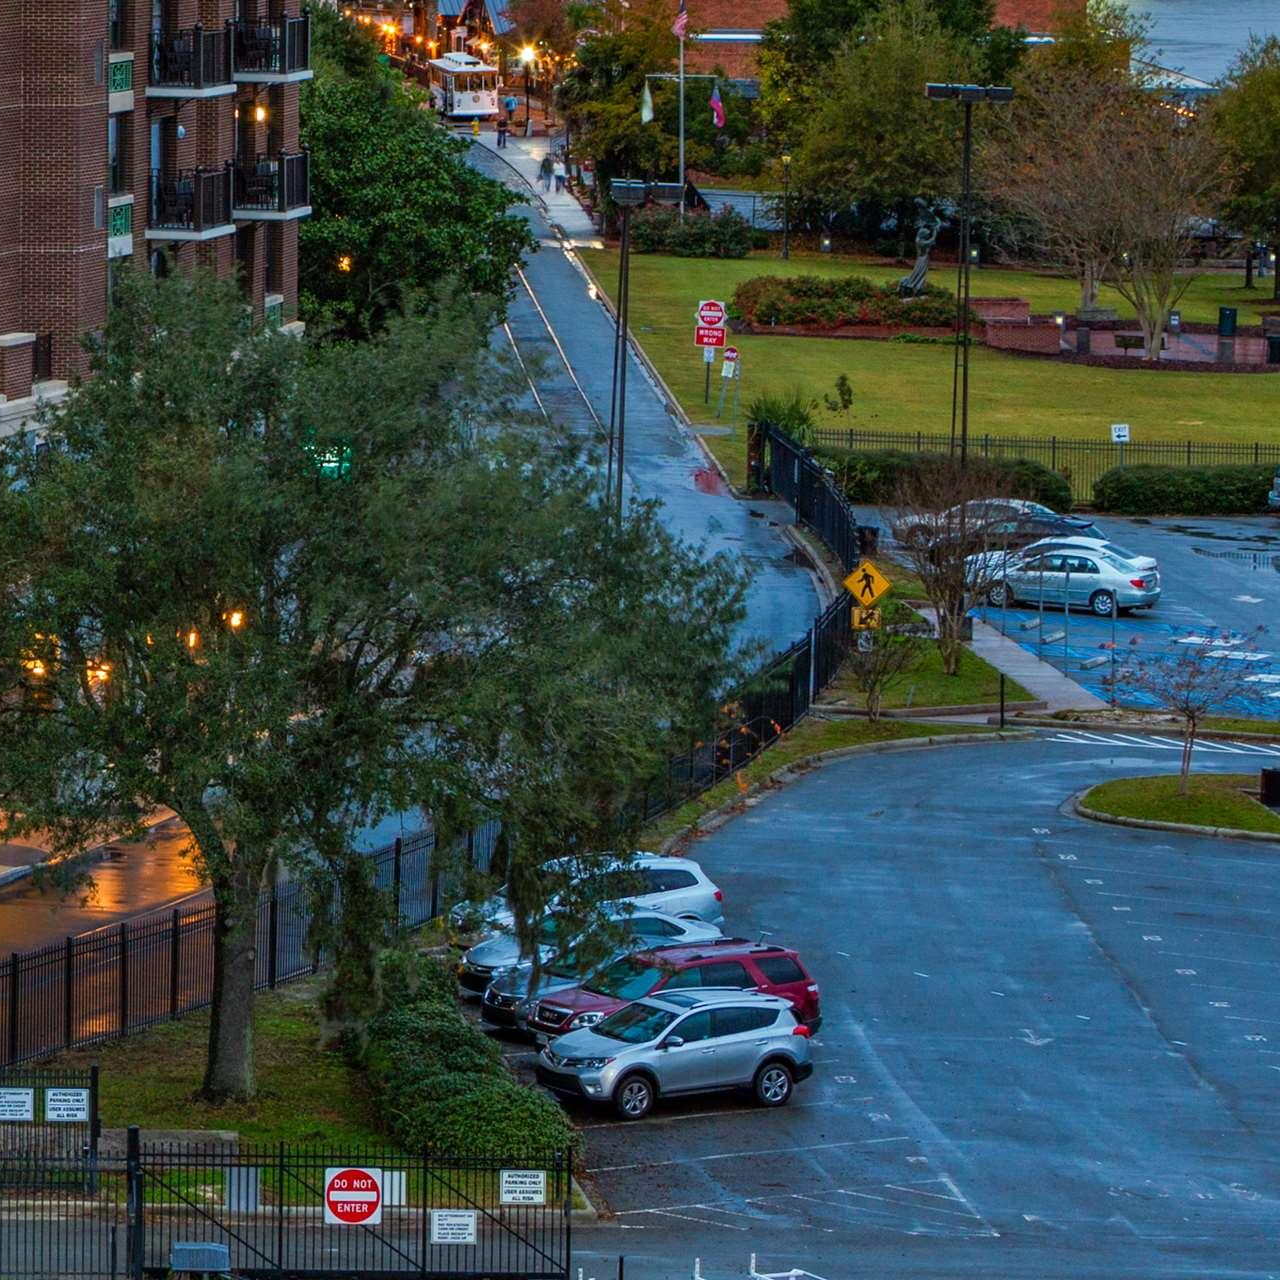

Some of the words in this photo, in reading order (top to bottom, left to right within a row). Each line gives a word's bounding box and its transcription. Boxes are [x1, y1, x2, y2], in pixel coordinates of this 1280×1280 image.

[699, 329, 723, 337] WRONG
[334, 1179, 348, 1188] DO
[353, 1179, 373, 1188] NOT
[337, 1203, 369, 1213] ENTER
